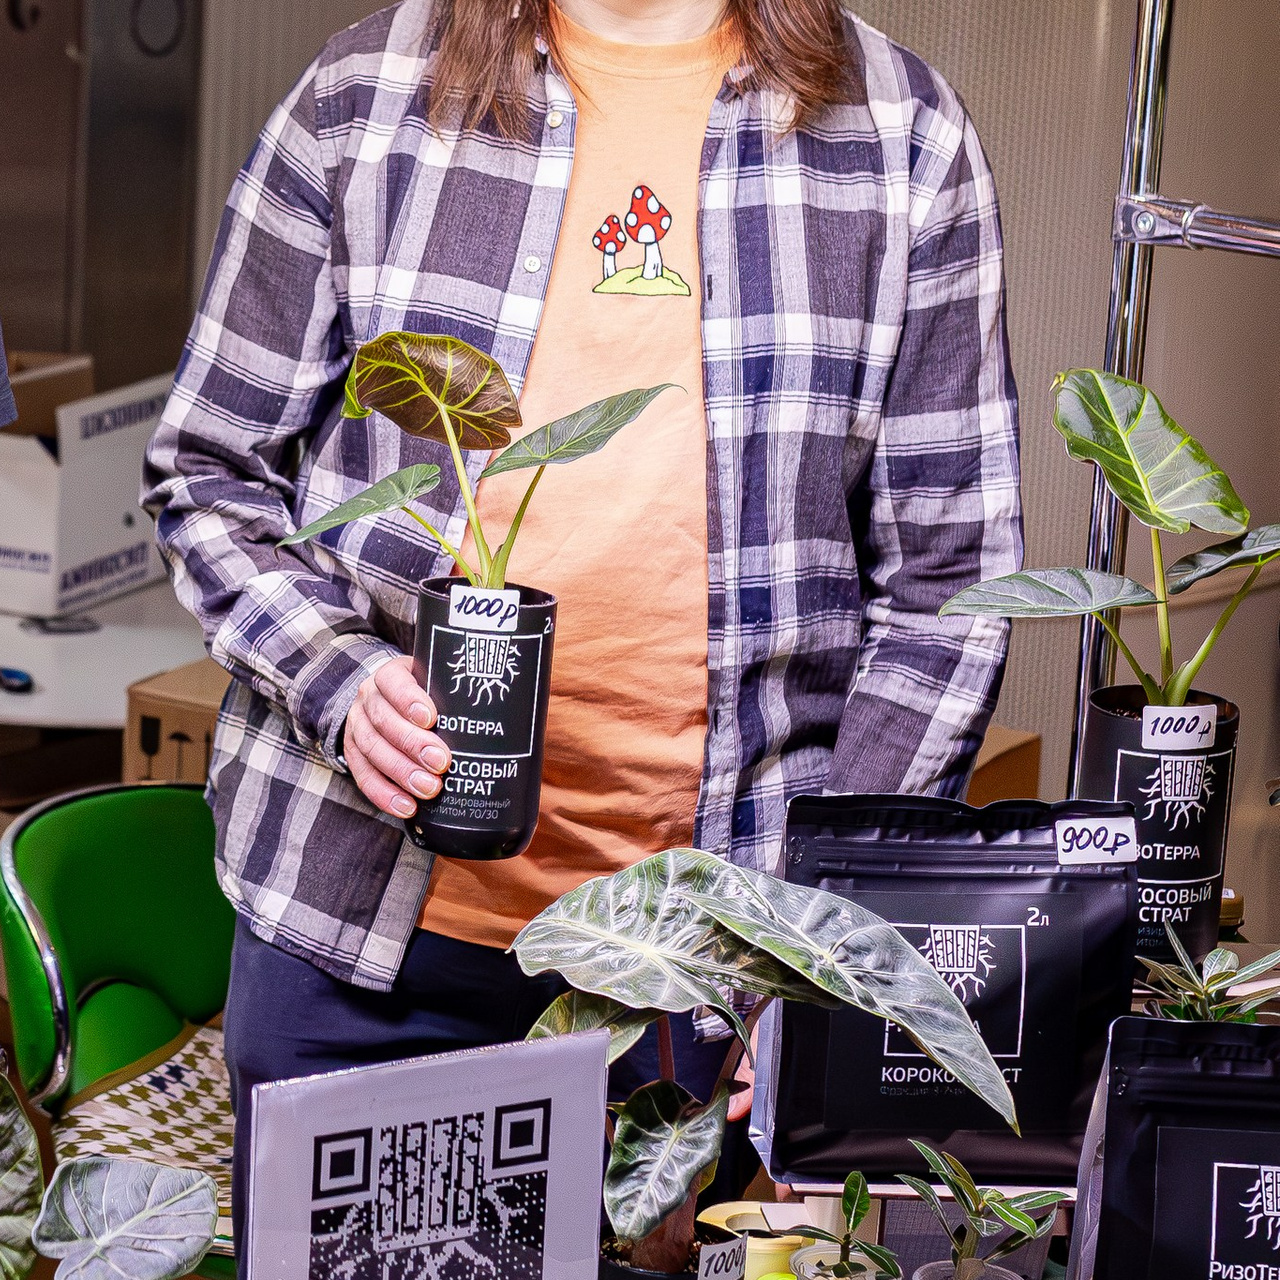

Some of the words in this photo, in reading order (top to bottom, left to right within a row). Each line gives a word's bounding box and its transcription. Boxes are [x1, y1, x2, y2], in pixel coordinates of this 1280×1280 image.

[436, 713, 505, 737] ИЗОТЕРРА
[447, 757, 518, 779] ОСОВЫЙ
[444, 775, 495, 797] СТРАТ
[440, 795, 512, 810] изированный
[469, 808, 499, 820] 70/30
[1135, 841, 1201, 861] ЗОТЕРРА
[1027, 906, 1050, 927] 2л
[1138, 905, 1192, 923] СТРАТ
